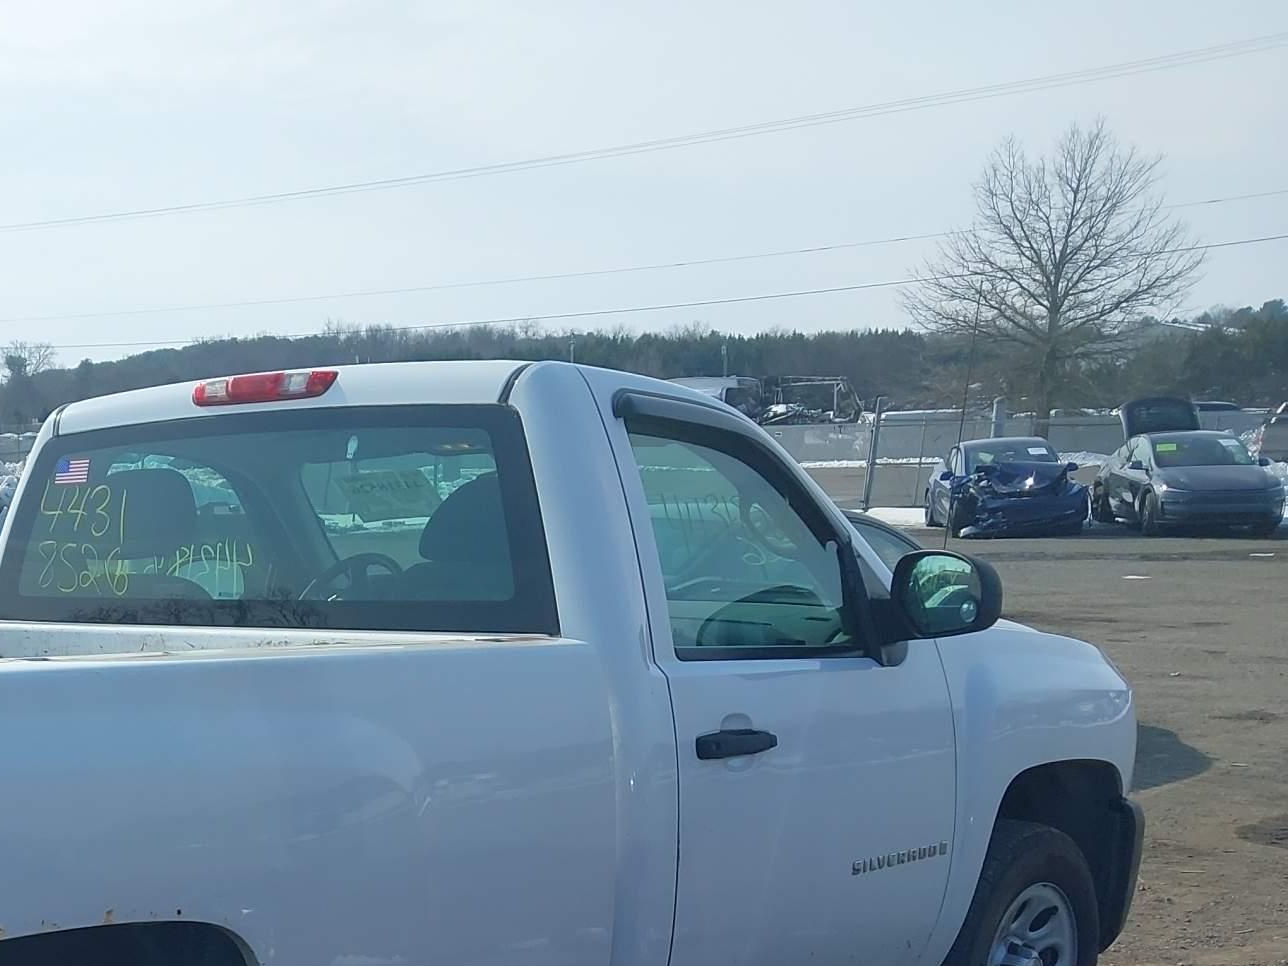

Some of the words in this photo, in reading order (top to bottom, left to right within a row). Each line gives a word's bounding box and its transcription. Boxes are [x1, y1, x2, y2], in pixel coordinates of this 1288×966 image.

[40, 479, 127, 544] 4431
[38, 541, 129, 595] 8526
[851, 844, 938, 876] SILVERADO
